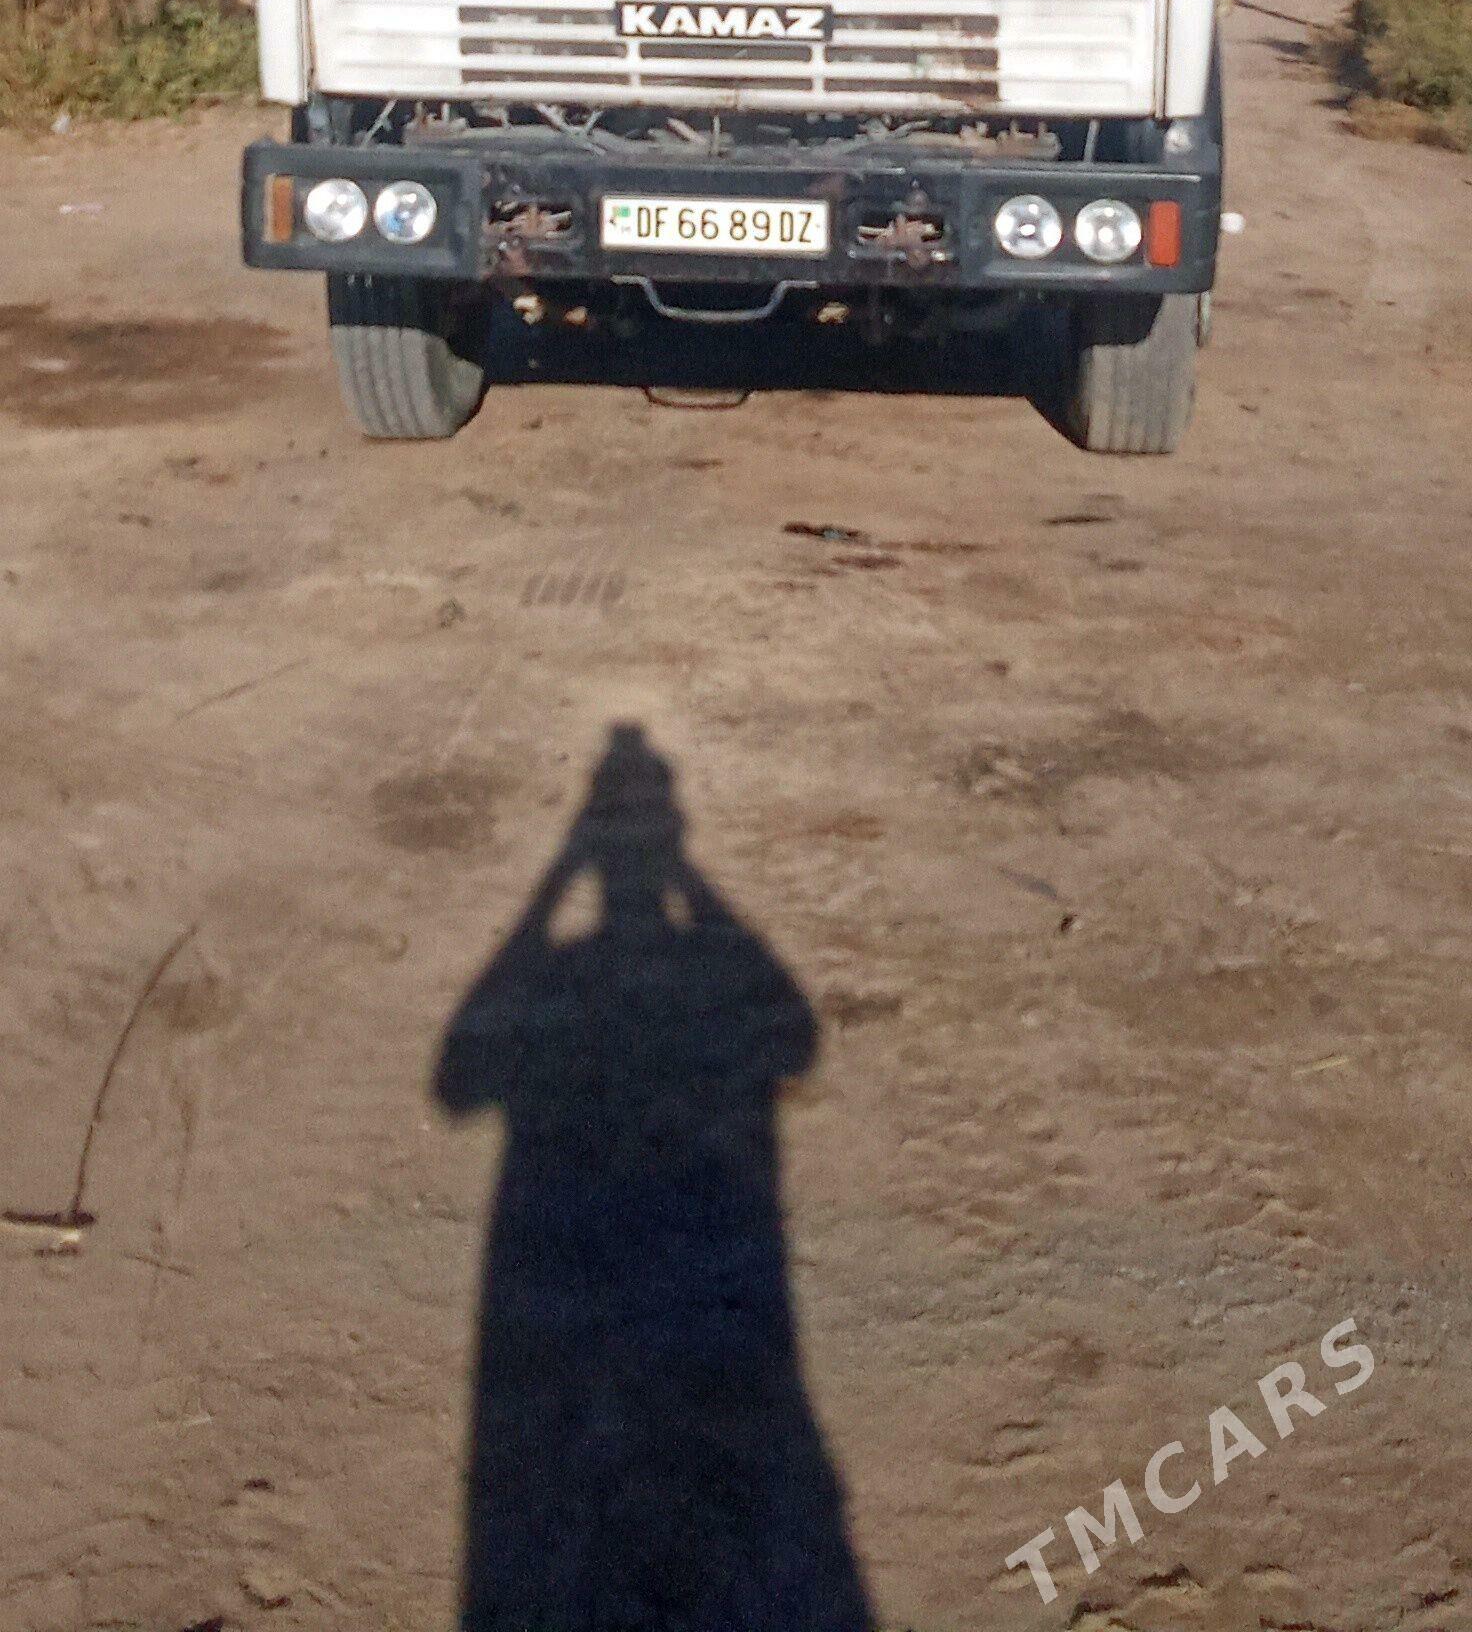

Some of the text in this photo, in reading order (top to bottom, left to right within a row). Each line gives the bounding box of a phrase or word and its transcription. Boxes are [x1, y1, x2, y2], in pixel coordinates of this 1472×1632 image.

[621, 3, 825, 39] KAMAZ
[636, 206, 812, 244] DF 66 89 DZ
